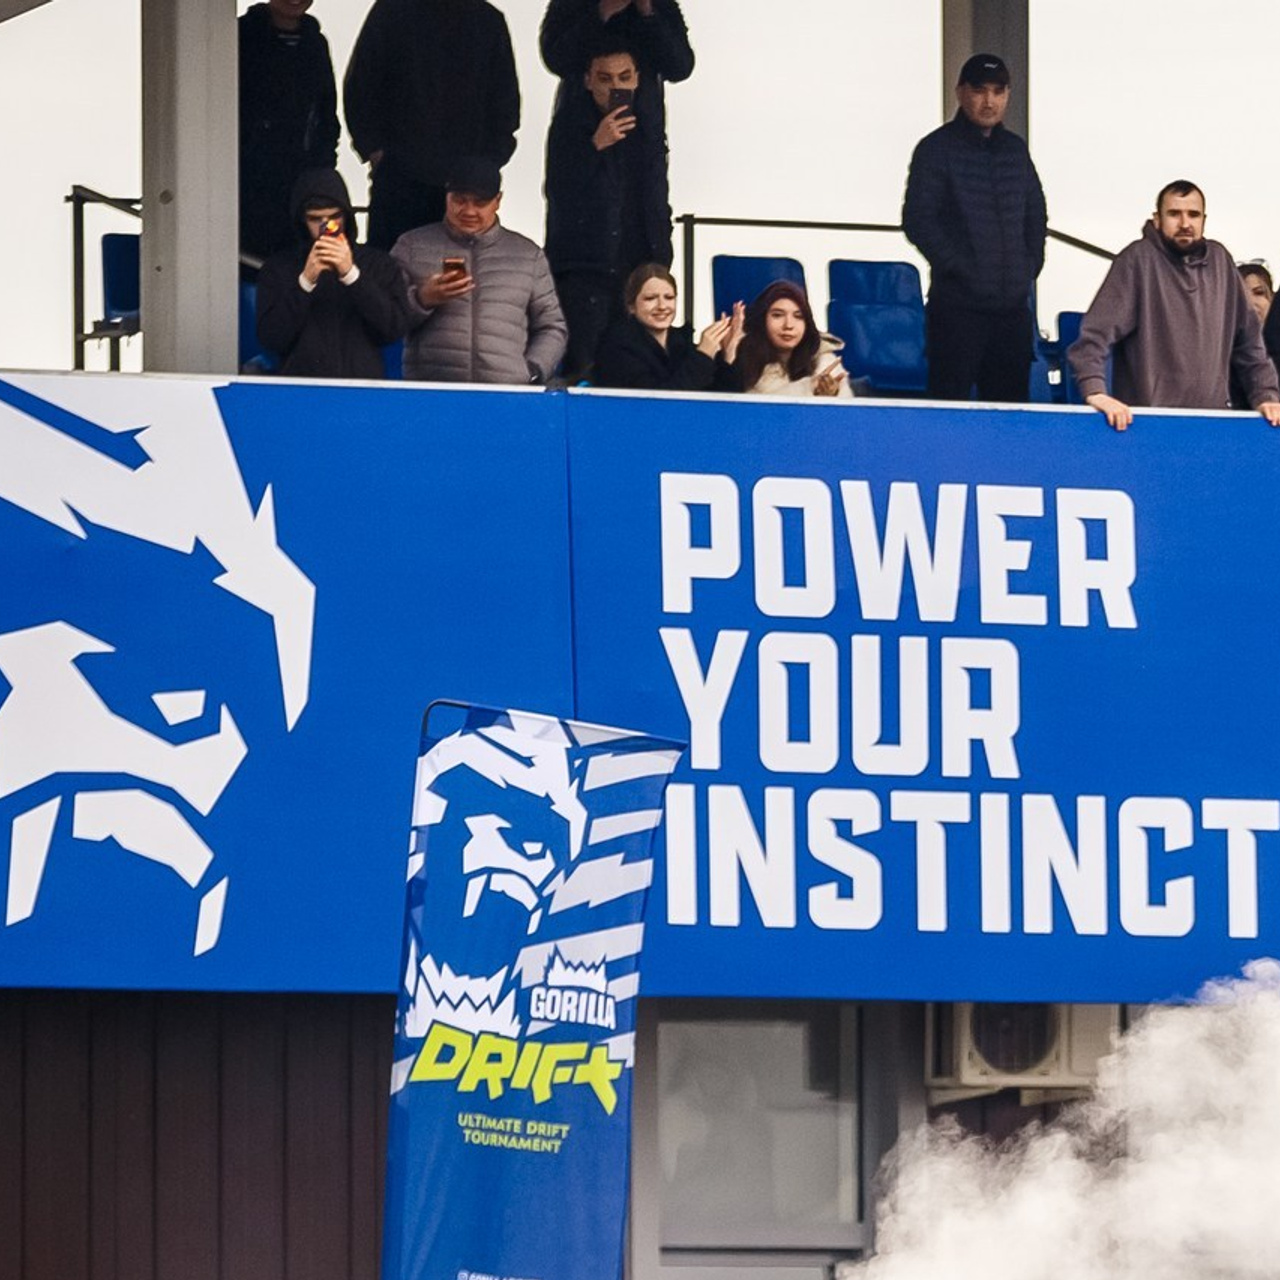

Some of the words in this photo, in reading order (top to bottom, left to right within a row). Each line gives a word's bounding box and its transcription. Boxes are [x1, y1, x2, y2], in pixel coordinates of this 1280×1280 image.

[659, 471, 1138, 629] POWER
[658, 626, 1022, 779] YOUR
[529, 986, 617, 1030] GORILLA
[408, 1021, 623, 1117] DRIFT
[457, 1111, 522, 1133] ULTIMATE
[526, 1120, 571, 1139] DRIFT
[462, 1129, 562, 1154] TOURNAMENT
